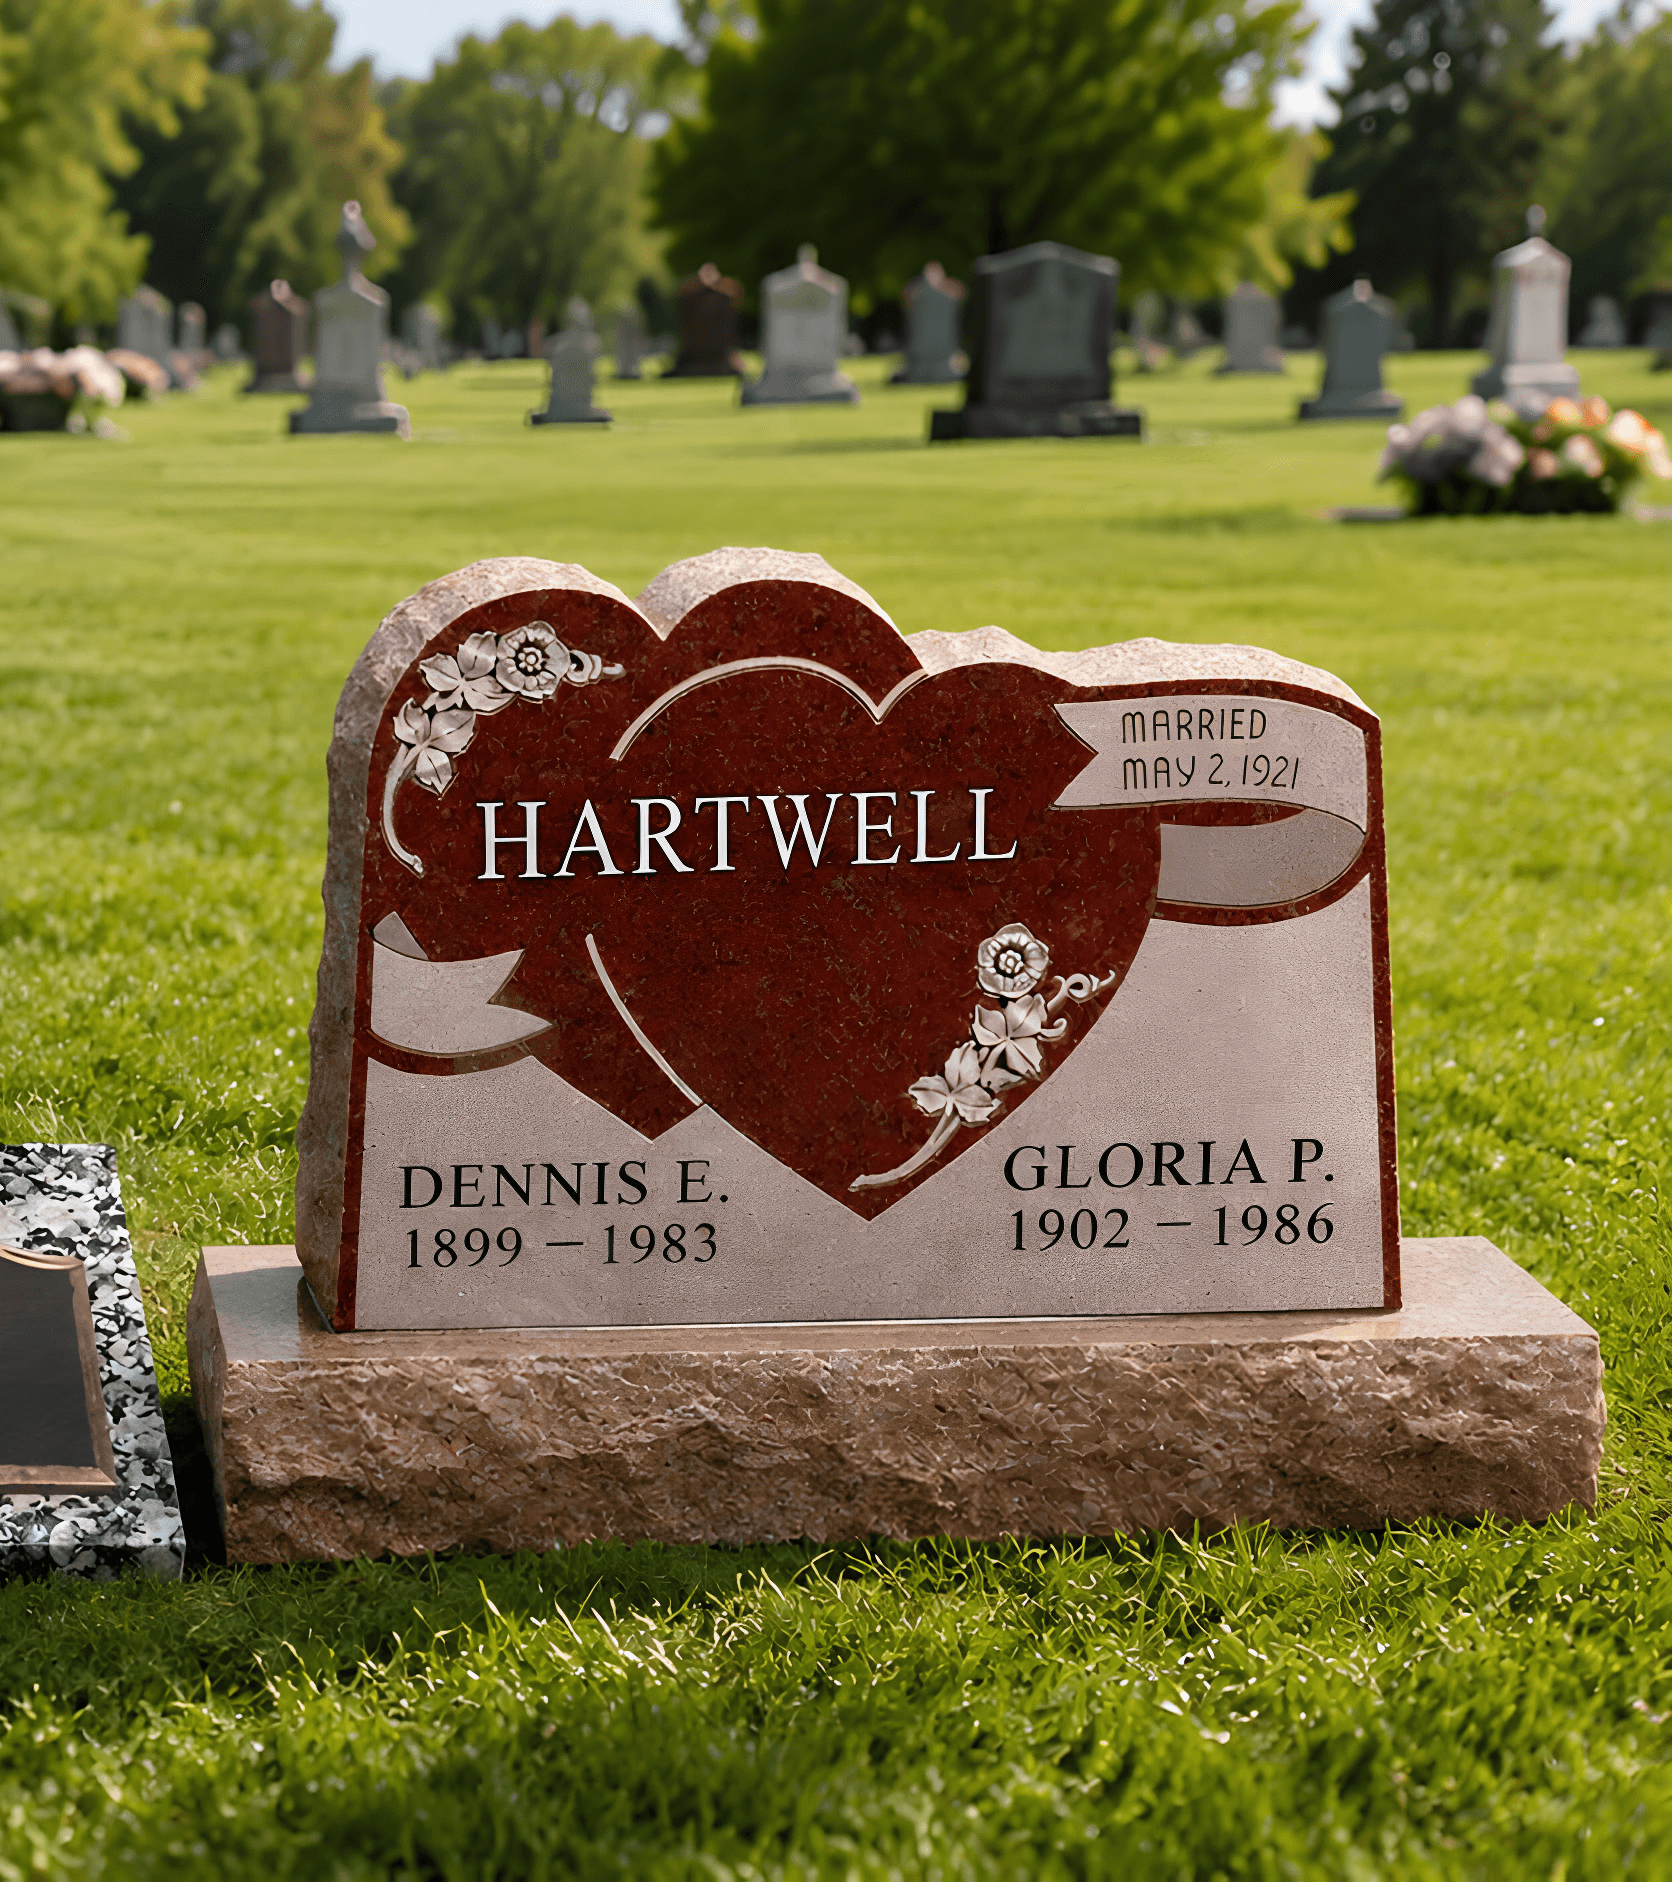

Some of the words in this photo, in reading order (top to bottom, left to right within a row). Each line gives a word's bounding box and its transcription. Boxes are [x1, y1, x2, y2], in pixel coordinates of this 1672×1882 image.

[1122, 708, 1267, 743] MARRIED
[1123, 755, 1196, 790] MAY
[476, 788, 1018, 880] HARTWELL
[398, 1160, 648, 1209] DENNIS
[676, 1160, 728, 1204] E.
[1003, 1138, 1267, 1191] GLORIA
[1288, 1138, 1334, 1183] P.
[406, 1226, 522, 1268] 1899
[603, 1222, 717, 1264] 1983
[1011, 1208, 1129, 1251] 1902
[1213, 1202, 1334, 1246] 1986
